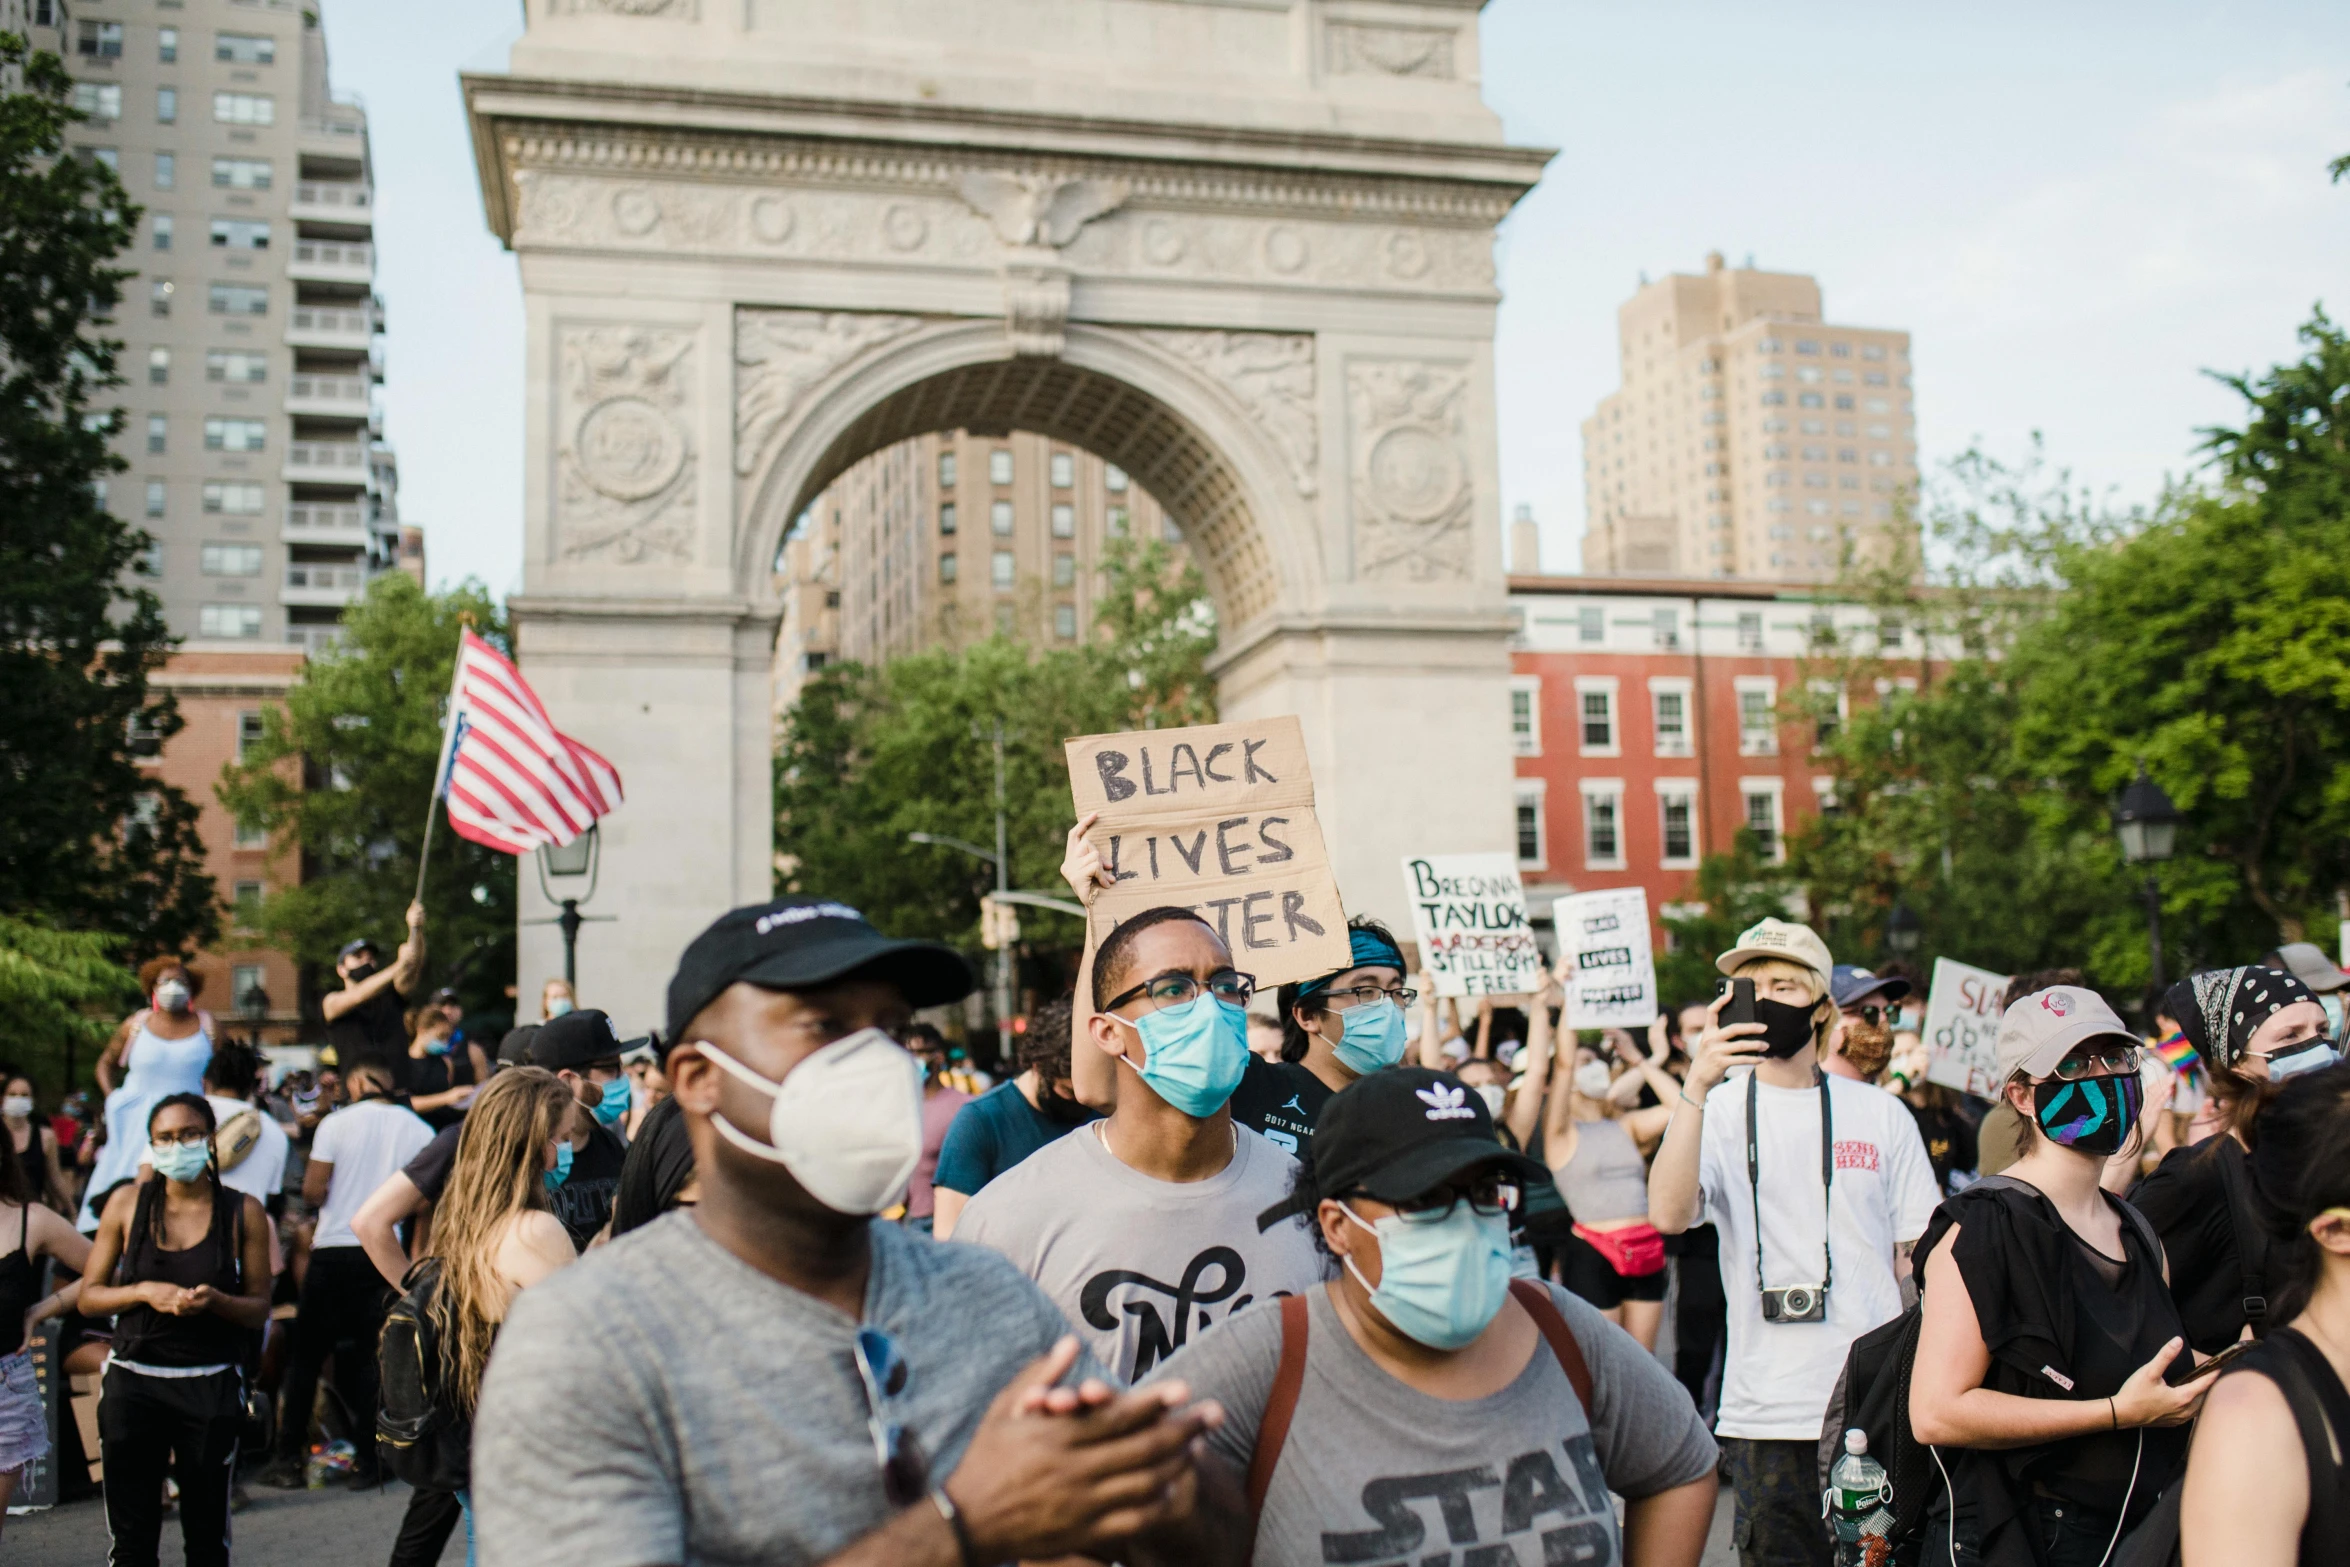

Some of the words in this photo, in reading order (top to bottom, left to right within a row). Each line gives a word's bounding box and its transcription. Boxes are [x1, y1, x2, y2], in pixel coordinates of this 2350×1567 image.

[1095, 738, 1278, 803] BLACK
[1109, 816, 1294, 881] LIVES
[1112, 890, 1326, 952] TER
[1420, 902, 1527, 929] TAYLOR
[1433, 952, 1492, 973] STILL
[1581, 949, 1630, 968] LIVES
[1465, 974, 1519, 995] FREE
[1264, 1113, 1287, 1128] 2017
[1836, 1155, 1880, 1171] HELP
